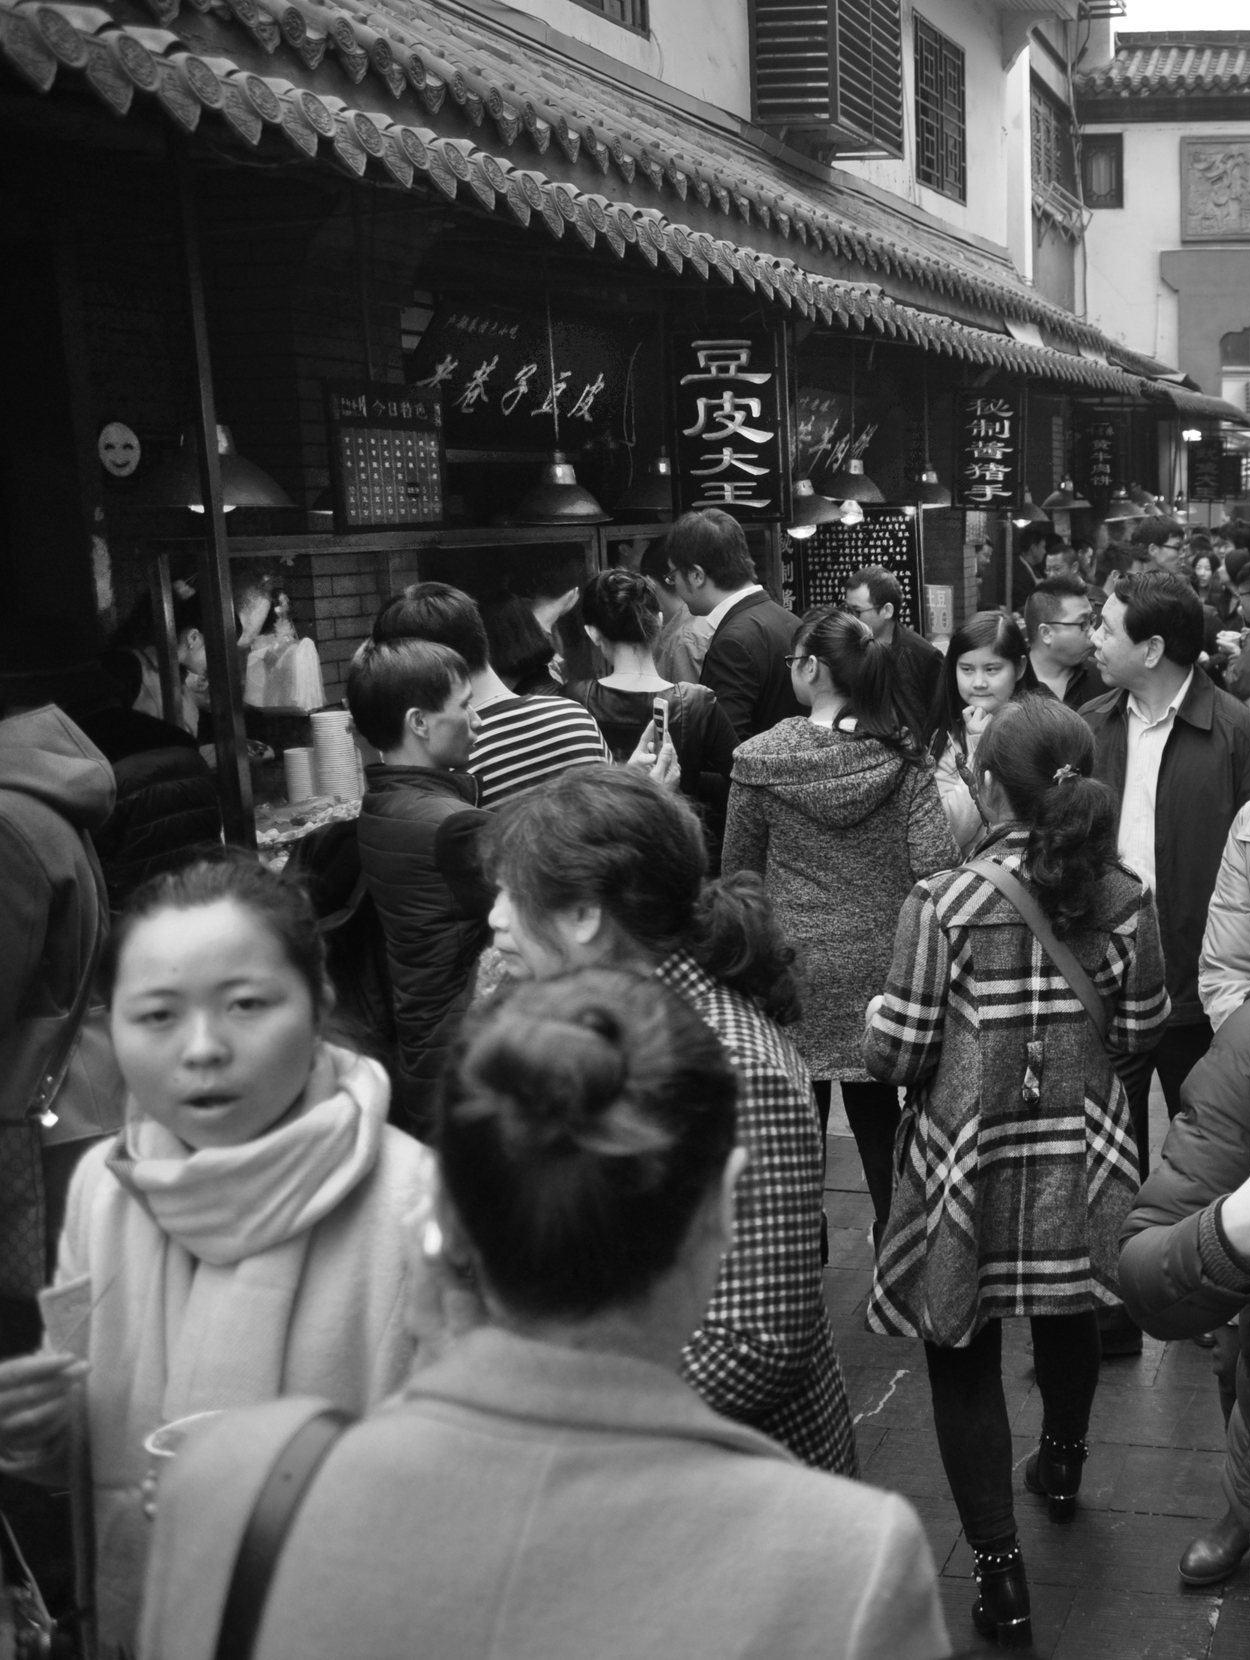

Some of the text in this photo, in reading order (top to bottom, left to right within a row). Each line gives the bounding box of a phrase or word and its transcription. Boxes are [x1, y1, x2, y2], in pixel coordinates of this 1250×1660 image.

[680, 340, 774, 508] 豆皮大王
[964, 398, 1014, 502] 秘制酱猪手
